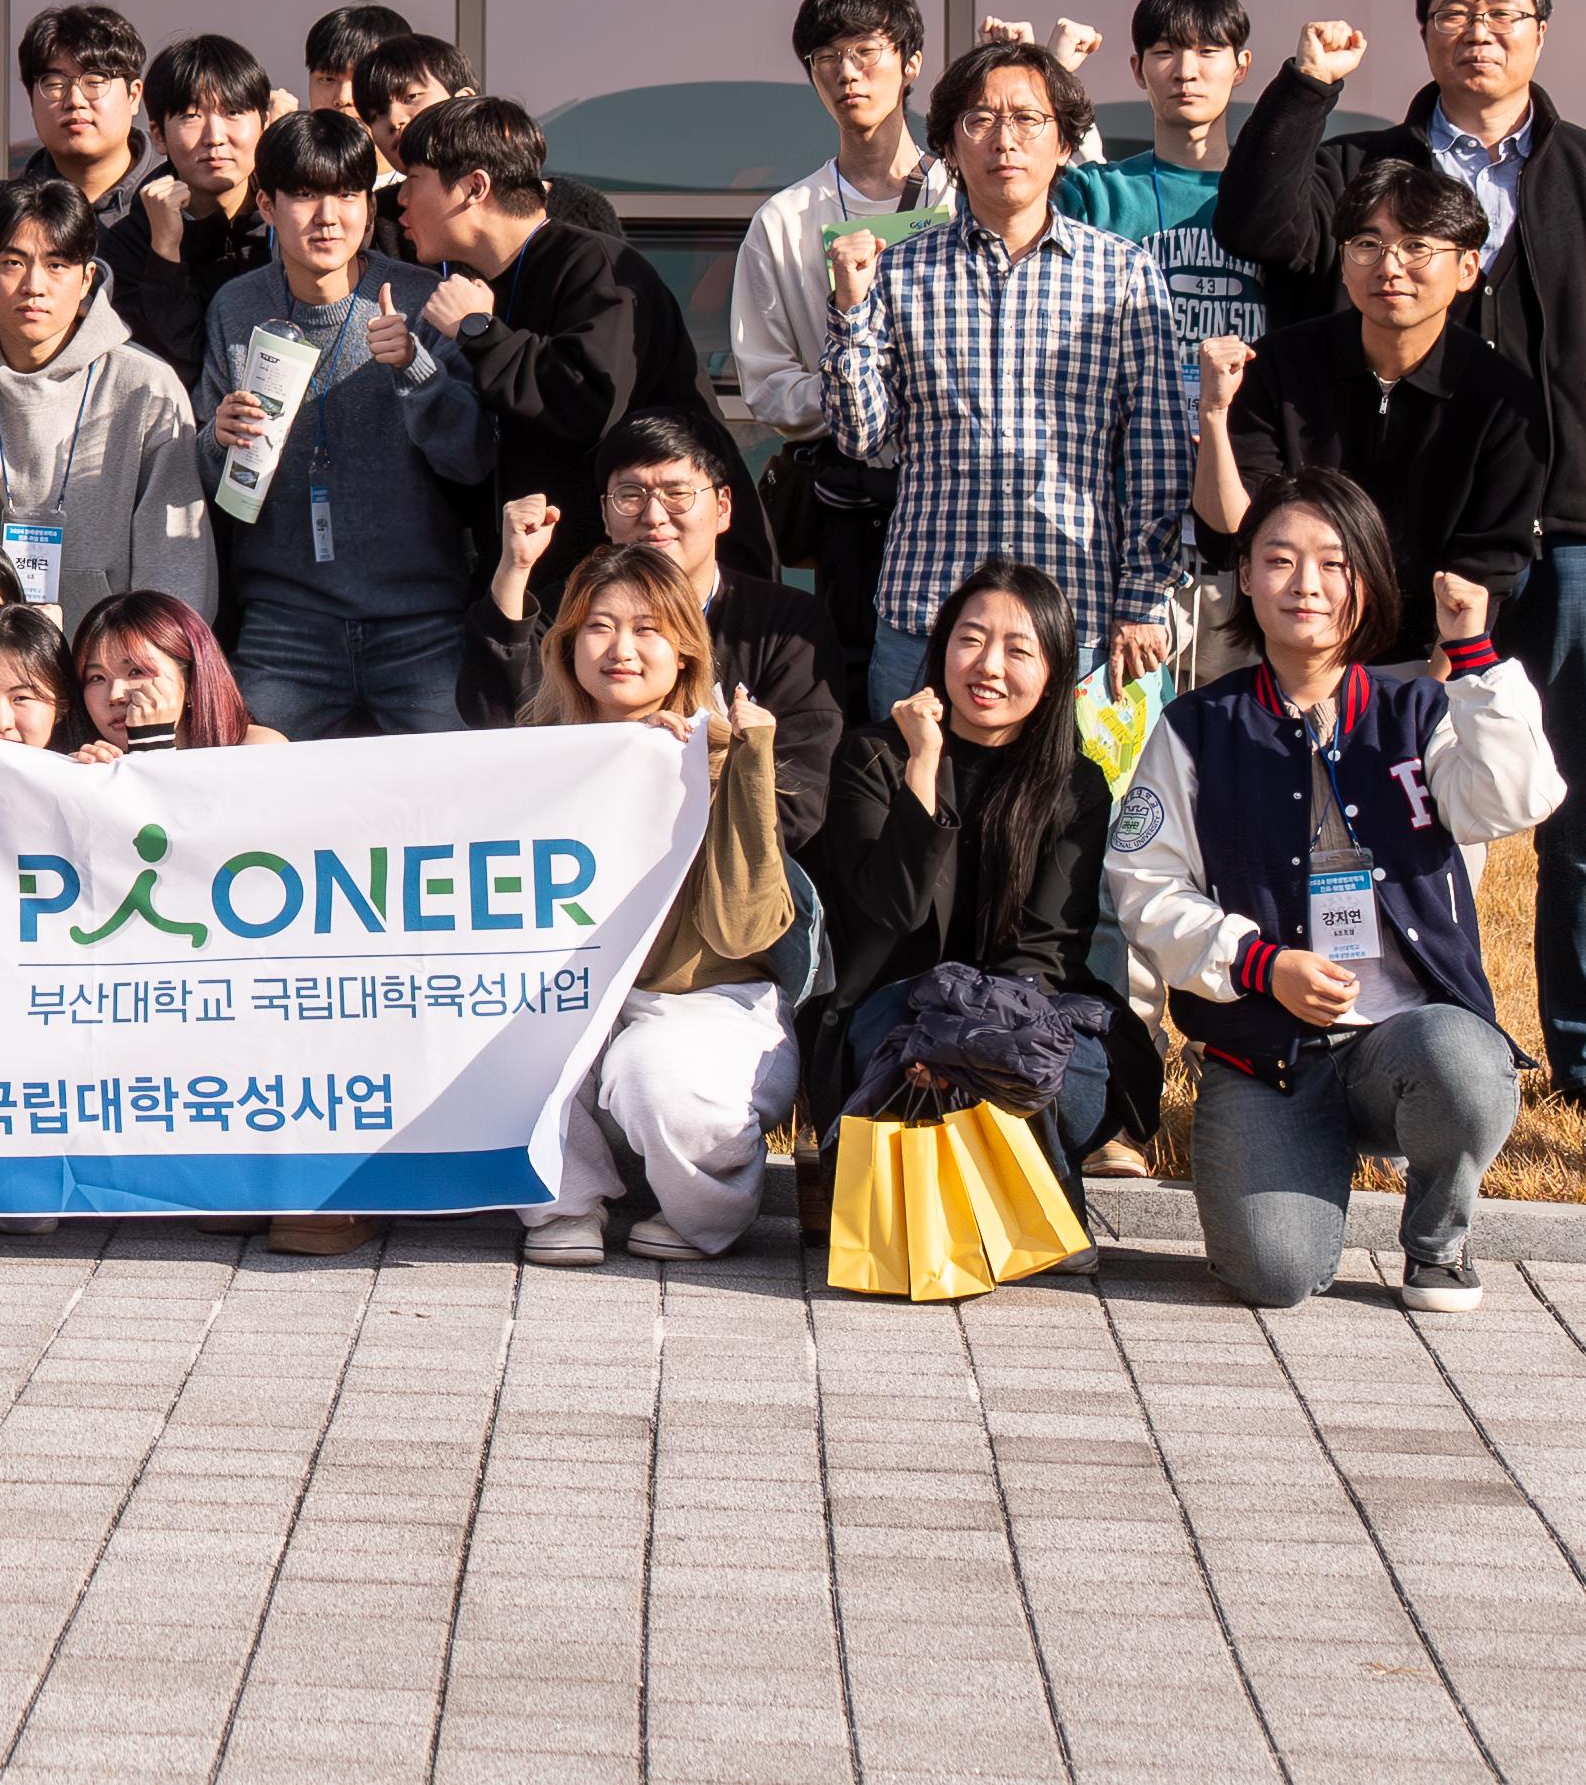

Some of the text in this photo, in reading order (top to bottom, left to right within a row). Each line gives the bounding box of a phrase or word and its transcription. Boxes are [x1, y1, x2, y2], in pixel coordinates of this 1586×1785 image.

[1195, 276, 1216, 294] 43
[1173, 296, 1266, 344] SCONSIN
[15, 557, 49, 572] 정대근
[1322, 909, 1362, 926] 강지연
[26, 965, 594, 1026] 부산대학교 국립대학육성사업
